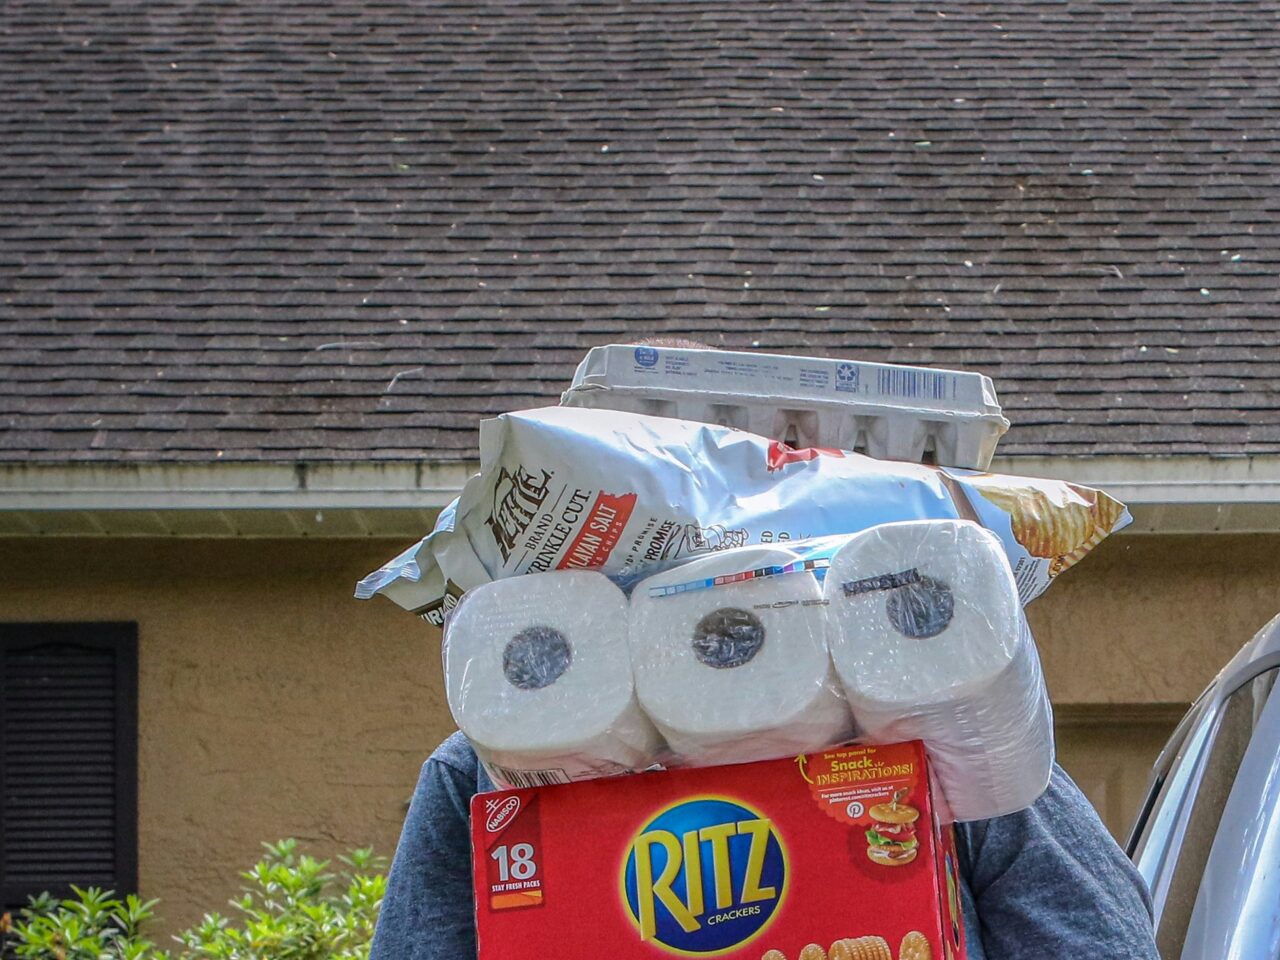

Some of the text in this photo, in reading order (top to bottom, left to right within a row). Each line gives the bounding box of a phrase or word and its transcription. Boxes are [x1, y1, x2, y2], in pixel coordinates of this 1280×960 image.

[559, 486, 591, 526] CUT
[588, 501, 617, 535] SALT
[524, 511, 554, 552] BRAND
[643, 518, 676, 561] PROMISE
[816, 763, 914, 786] INSPIRATIONS!
[831, 756, 873, 772] Snack
[488, 798, 517, 831] NABISCO
[491, 843, 537, 881] 18
[491, 879, 540, 892] STAY FRESH PACKS
[634, 819, 775, 941] RITZ
[707, 905, 761, 925] CRACKERS
